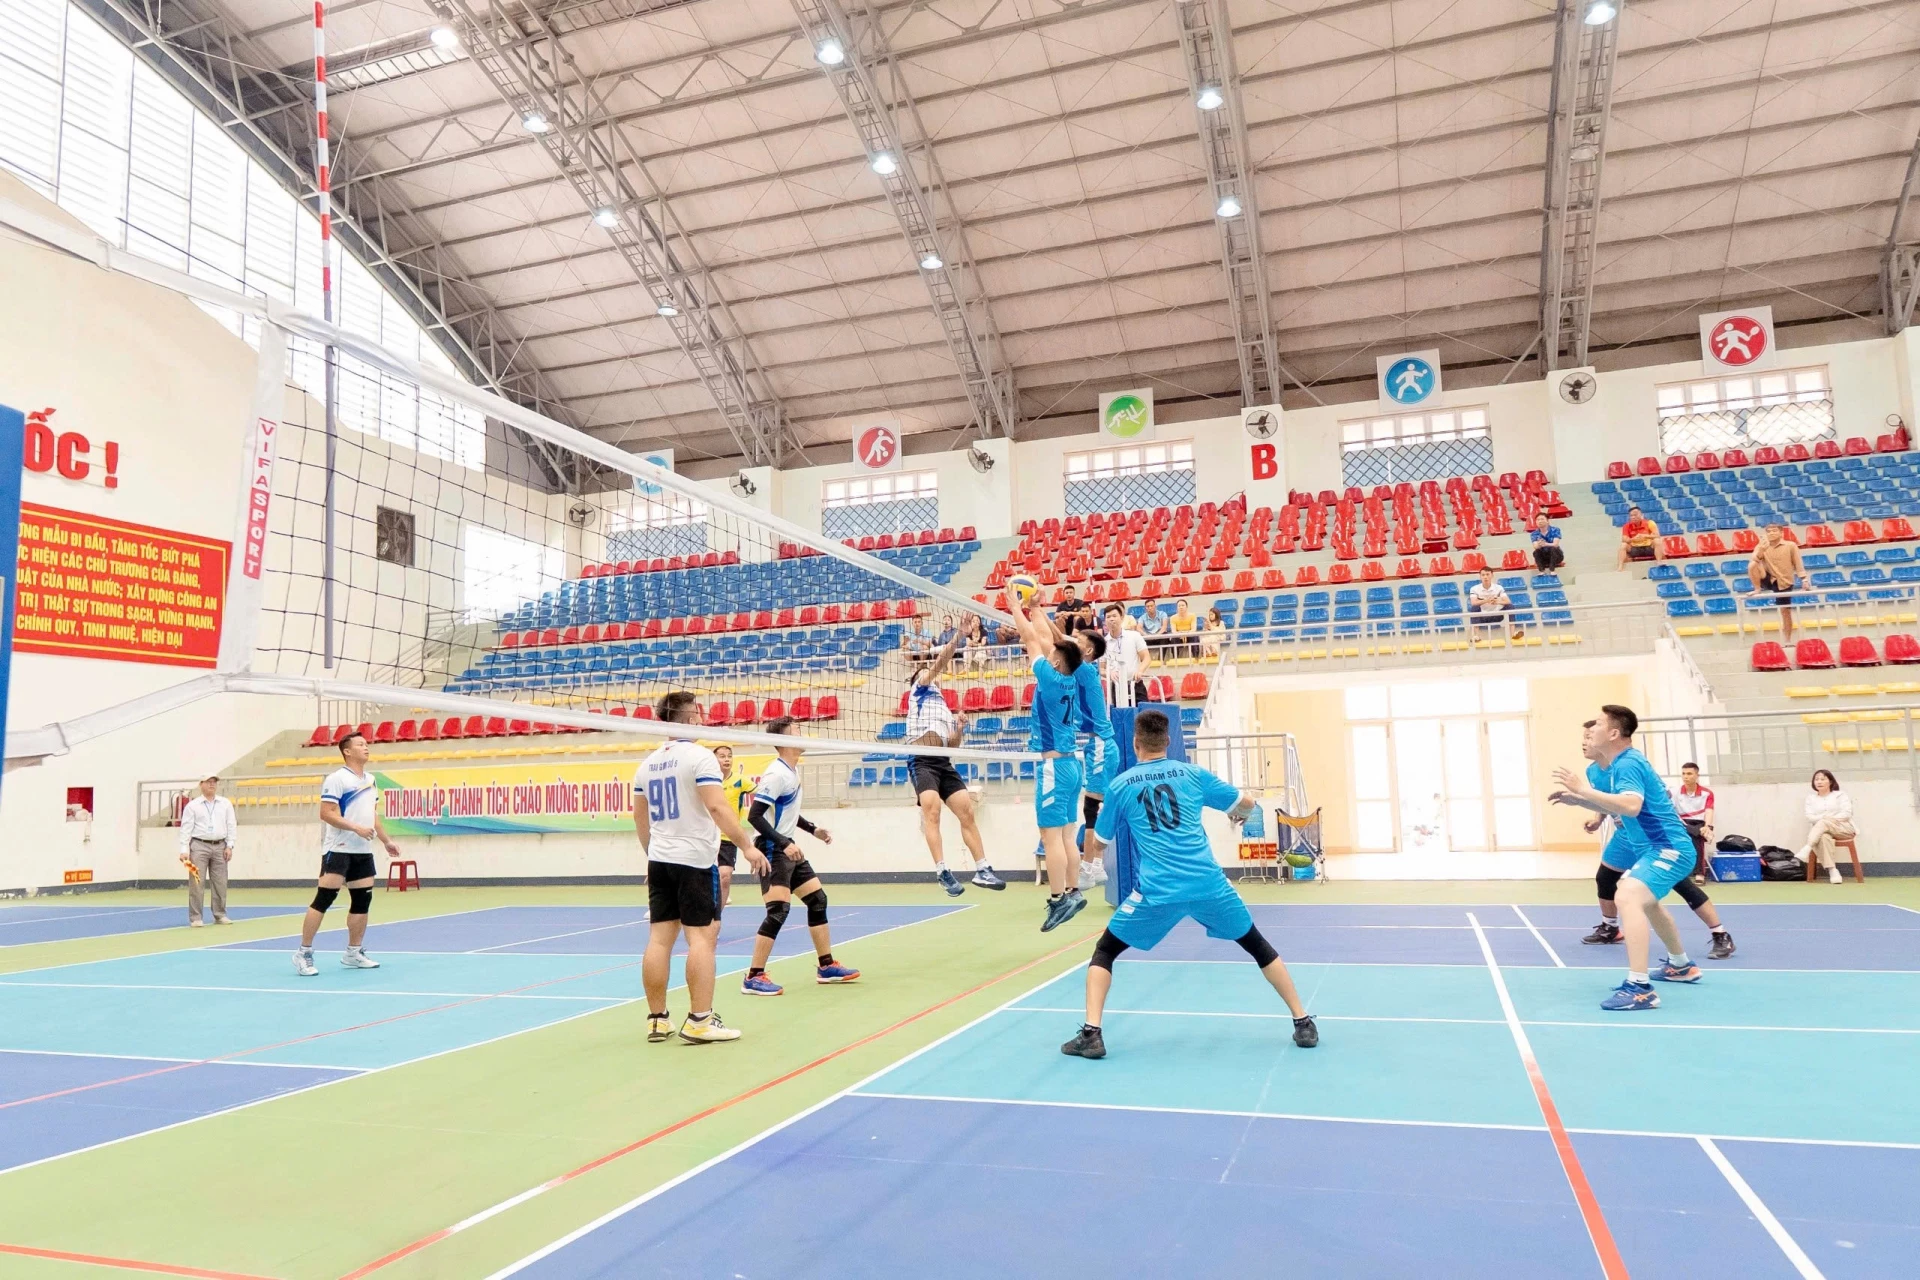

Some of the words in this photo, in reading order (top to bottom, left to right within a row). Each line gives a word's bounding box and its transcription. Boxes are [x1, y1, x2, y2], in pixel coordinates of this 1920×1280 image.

[105, 441, 118, 488] !
[1251, 444, 1278, 480] B
[247, 423, 274, 573] VIFASPORT
[31, 546, 59, 567] HIỆN
[61, 551, 83, 569] CÁC
[86, 553, 107, 573] CHỦ
[151, 563, 170, 583] CỦA
[140, 541, 159, 561] TỐC
[182, 551, 200, 568] PHÁ
[20, 591, 39, 612] TRỊ
[43, 594, 70, 614] THẬT
[90, 601, 124, 619] TRONG
[41, 567, 64, 589] CỦA
[66, 574, 89, 593] NHÀ
[126, 583, 146, 600] XÂY
[177, 591, 202, 608] CÔNG
[204, 596, 217, 610] AN
[16, 613, 52, 632] CHÍNH
[82, 621, 106, 638] TINH
[141, 627, 164, 646] HIỆN
[1145, 773, 1165, 781] GIAM
[1179, 769, 1185, 777] 3
[384, 790, 400, 817] THI
[403, 789, 423, 817] ĐUA
[426, 783, 446, 823] LẬP
[448, 782, 483, 815] THÀNH
[486, 780, 509, 815] TÍCH
[513, 779, 541, 814] CHÀO
[545, 777, 578, 813] MỪNG
[604, 776, 623, 819] HỘI
[649, 776, 680, 821] 90
[1136, 783, 1180, 833] 10
